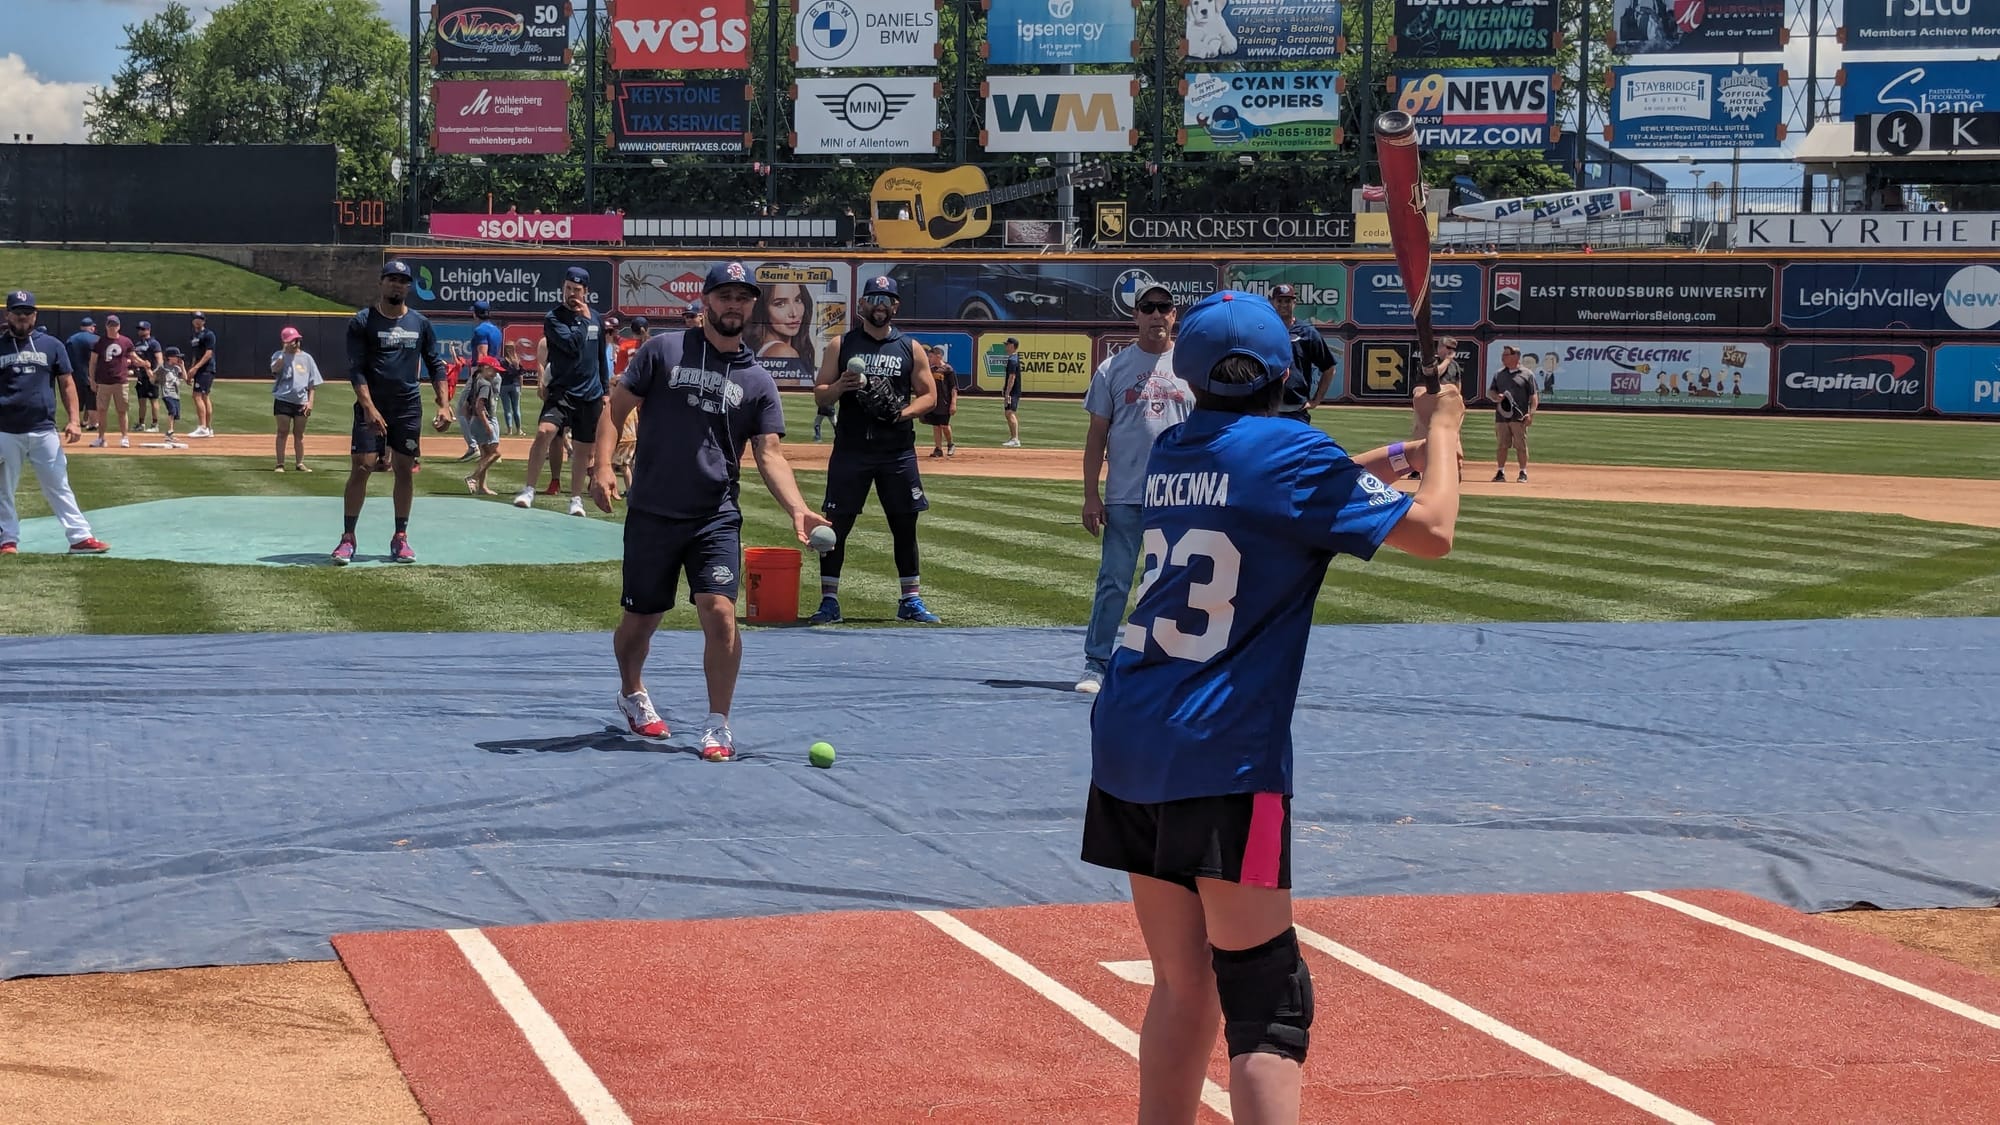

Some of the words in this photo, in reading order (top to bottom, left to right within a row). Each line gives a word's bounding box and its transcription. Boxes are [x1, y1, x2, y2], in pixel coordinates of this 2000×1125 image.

[535, 5, 558, 24] 50
[1230, 7, 1276, 16] CANINE
[1433, 7, 1535, 30] POWERING
[866, 12, 934, 28] DANIELS
[526, 25, 566, 38] Years!
[614, 7, 747, 54] weis
[880, 30, 920, 44] BMW
[1017, 19, 1104, 42] igsenergy
[1238, 26, 1256, 35] Day
[1290, 25, 1335, 34] Boarding
[1860, 28, 1916, 38] Members
[1920, 28, 1968, 36] Achieve
[1238, 36, 1278, 46] Training
[1287, 36, 1335, 44] Grooming
[1440, 30, 1460, 41] THE
[1458, 28, 1549, 50] IRONPIGS
[1247, 45, 1335, 58] www.lopci.com
[1232, 76, 1284, 90] CYAN
[1293, 76, 1334, 90] SKY
[1634, 81, 1696, 92] STAYBRIDGE
[494, 96, 542, 106] Muhlenberg
[630, 88, 720, 104] KEYSTONE
[1241, 94, 1324, 108] COPIERS
[1398, 73, 1446, 116] 69
[1448, 80, 1546, 112] NEWS
[494, 106, 524, 116] College
[850, 102, 882, 114] MINI
[992, 94, 1120, 132] WM
[630, 114, 664, 130] TAX
[669, 114, 742, 130] SERVICE
[469, 137, 532, 145] muhlenberg.edu
[618, 142, 742, 152] WWW.HOMERUNTAXES.COM
[820, 138, 843, 148] MINI
[846, 138, 858, 148] of
[859, 137, 909, 148] Allentown
[1130, 218, 1194, 238] CEDAR
[1196, 218, 1258, 240] CREST
[1262, 218, 1350, 238] COLLEGE
[1748, 218, 1880, 244] KLYR
[1896, 220, 1969, 242] THE
[440, 267, 492, 286] Lehigh
[494, 267, 541, 287] Valley
[760, 270, 790, 280] Mane
[794, 271, 803, 280] 'n
[806, 271, 828, 280] Tail
[1499, 276, 1518, 286] ESU
[1165, 281, 1214, 292] DANIELS
[1530, 286, 1566, 298] EAST
[1570, 286, 1674, 298] STROUDSBURG
[1680, 286, 1768, 298] UNIVERSITY
[440, 286, 530, 304] Orthopedic
[534, 288, 599, 304] Instte
[1301, 284, 1340, 305] Ike
[1946, 289, 2000, 306] New
[1577, 310, 1716, 323] WhereWarriorsBelong.com
[1017, 352, 1050, 360] EVERY
[1053, 352, 1074, 360] DAY
[1564, 346, 1625, 362] SERVICE
[1627, 346, 1694, 362] ELECTRIC
[1020, 362, 1054, 374] GAME
[1058, 363, 1085, 374] DAY.
[1612, 376, 1640, 390] SEN
[1112, 528, 1242, 662] 23
